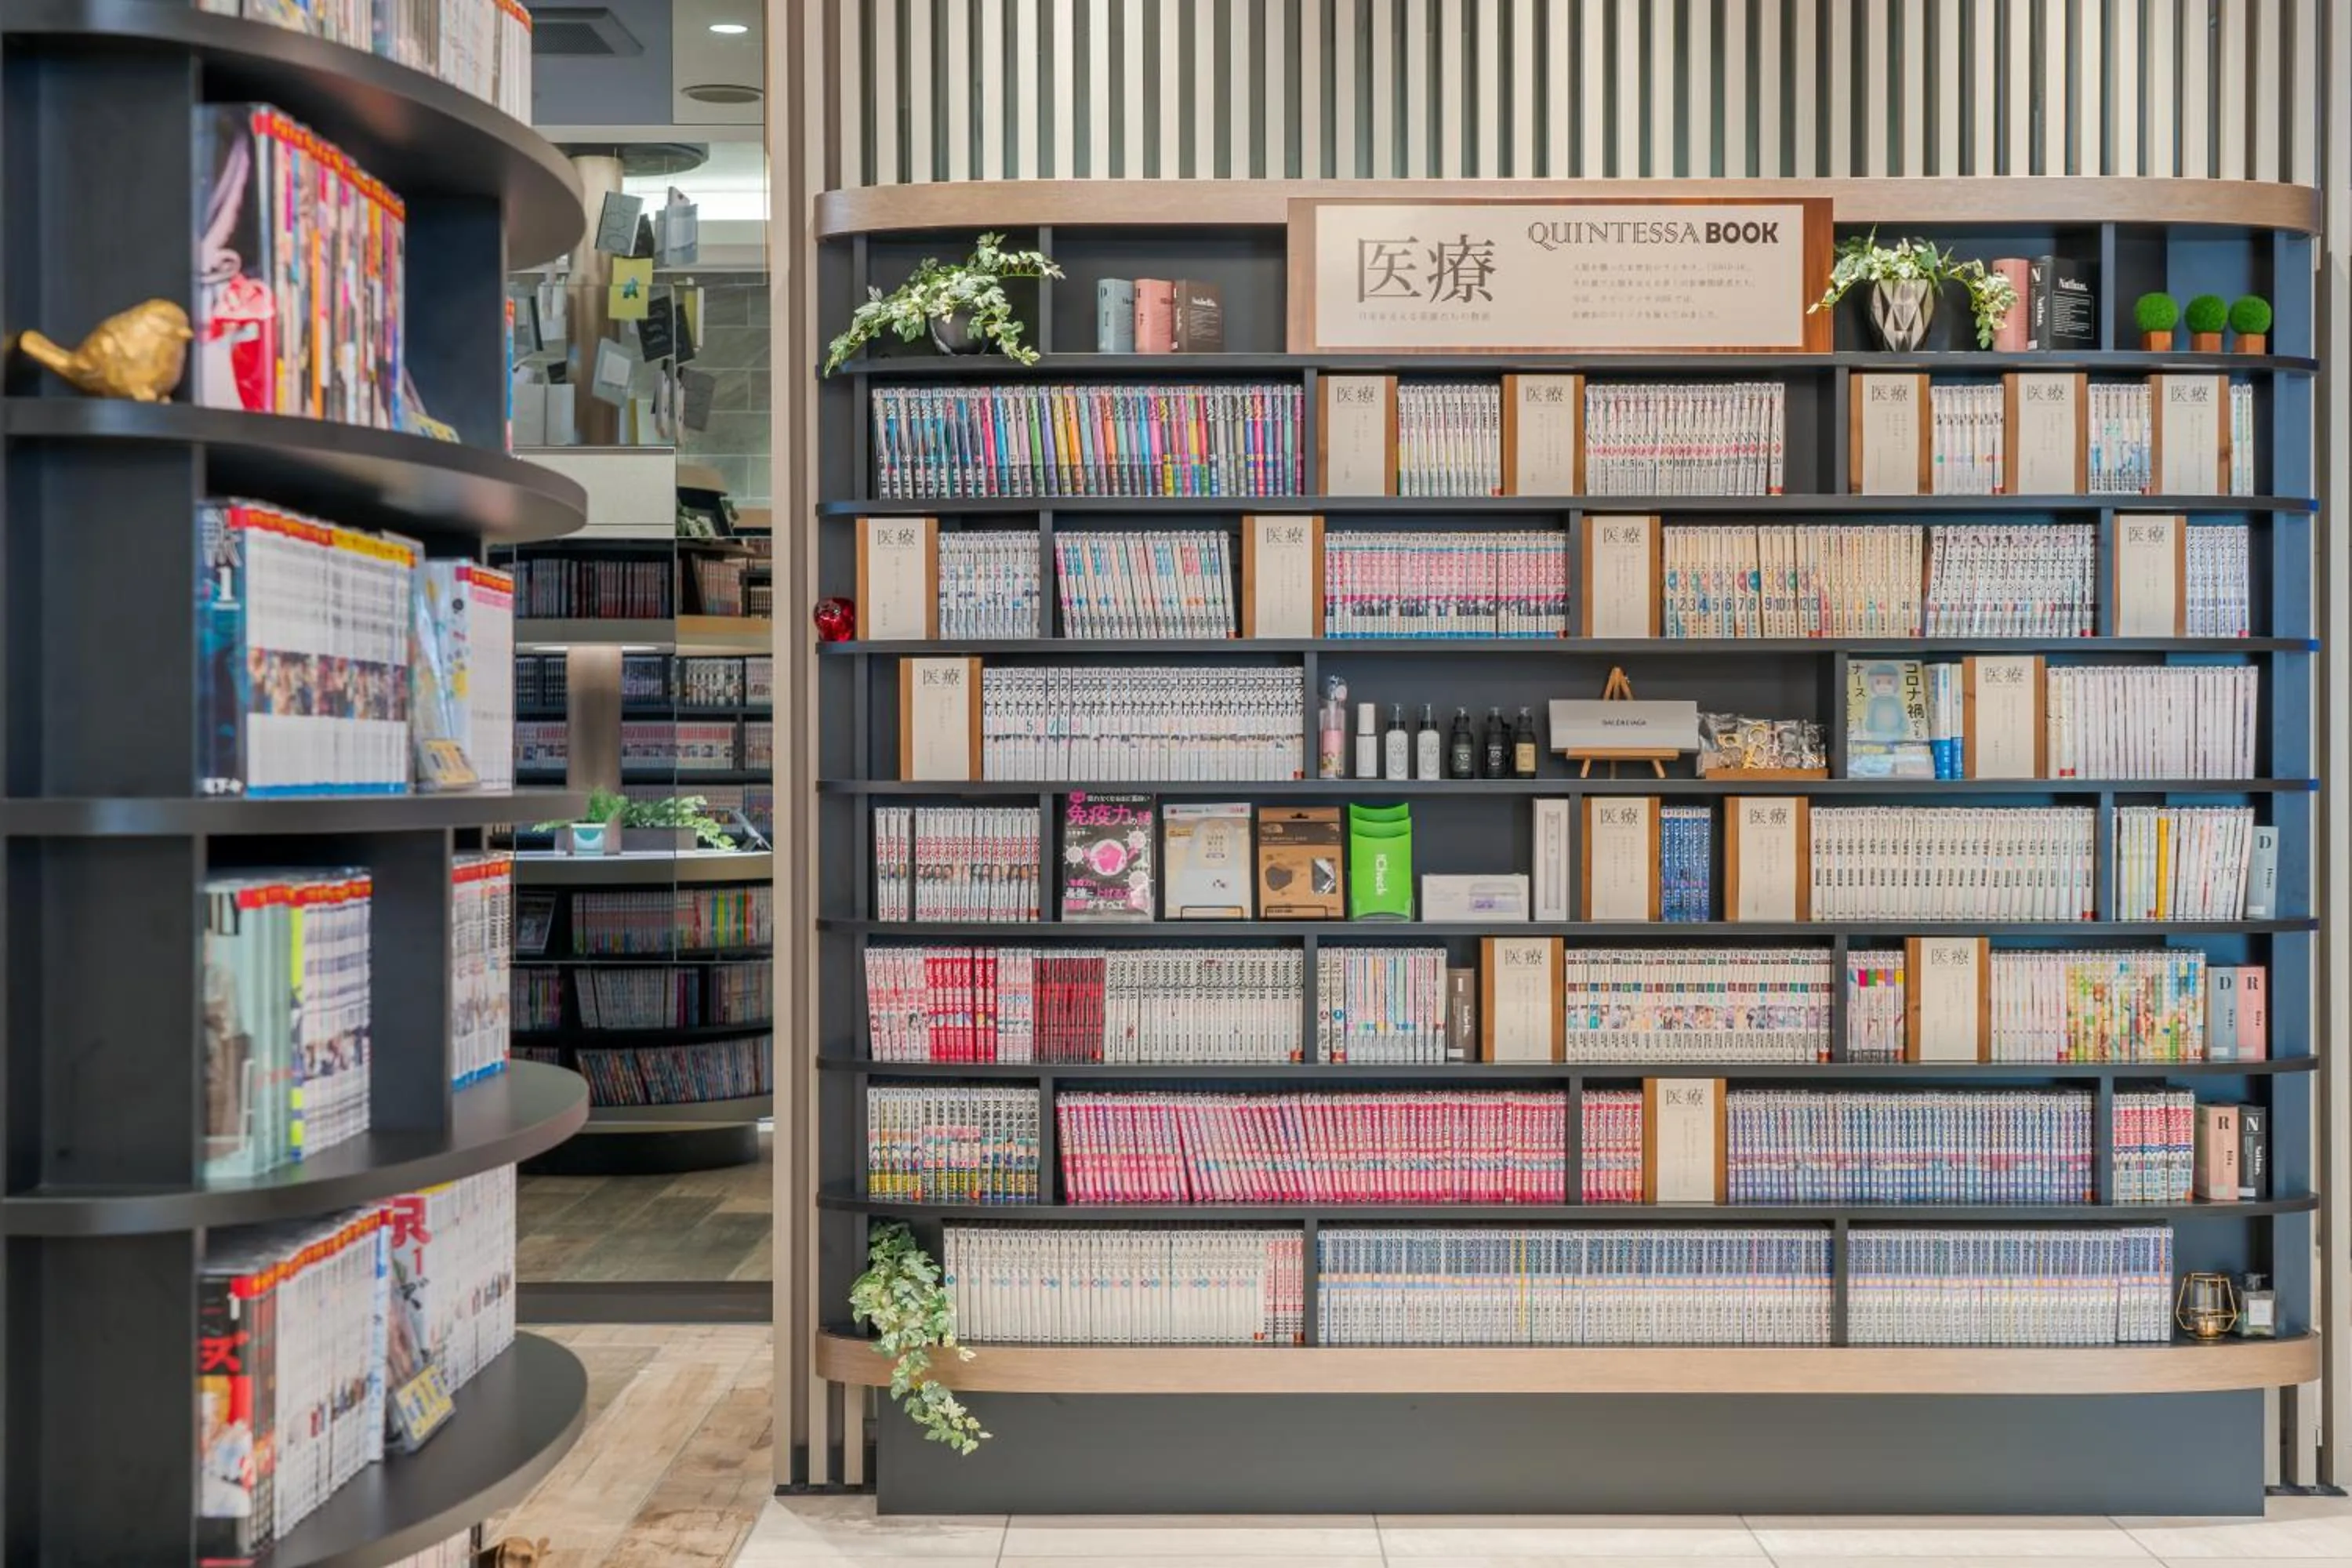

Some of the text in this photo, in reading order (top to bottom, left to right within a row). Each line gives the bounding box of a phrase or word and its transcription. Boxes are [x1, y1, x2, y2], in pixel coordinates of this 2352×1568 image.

[1528, 222, 1778, 251] QUINTESSA BOOK
[1358, 234, 1497, 303] 医療
[1337, 385, 1375, 404] 医療
[1526, 386, 1563, 402] 医療
[1871, 384, 1907, 402] 医療
[2027, 383, 2064, 401] 医療
[2171, 385, 2208, 402] 医療
[877, 528, 915, 545] 医療
[1266, 526, 1304, 544] 医療
[1603, 526, 1640, 544] 医療
[2129, 525, 2165, 543] 医療
[1679, 597, 1686, 612] 2
[1689, 597, 1696, 612] 3
[1725, 597, 1732, 612] 6
[1738, 597, 1744, 612] 7
[1749, 597, 1756, 612] 8
[1765, 597, 1772, 612] 9
[1774, 597, 1785, 612] 10
[923, 668, 960, 685] 医療
[1851, 664, 1866, 698] ナース
[1984, 666, 2023, 684] 医療
[1600, 807, 1638, 825] 医療
[1749, 808, 1787, 825] 医療
[2259, 835, 2271, 849] D
[1504, 949, 1542, 965] 医療
[1931, 947, 1969, 965] 医療
[2220, 976, 2232, 990] D
[2247, 976, 2259, 990] R
[1666, 1088, 1704, 1106] 医療
[2218, 1116, 2230, 1130] R
[2245, 1116, 2259, 1131] N
